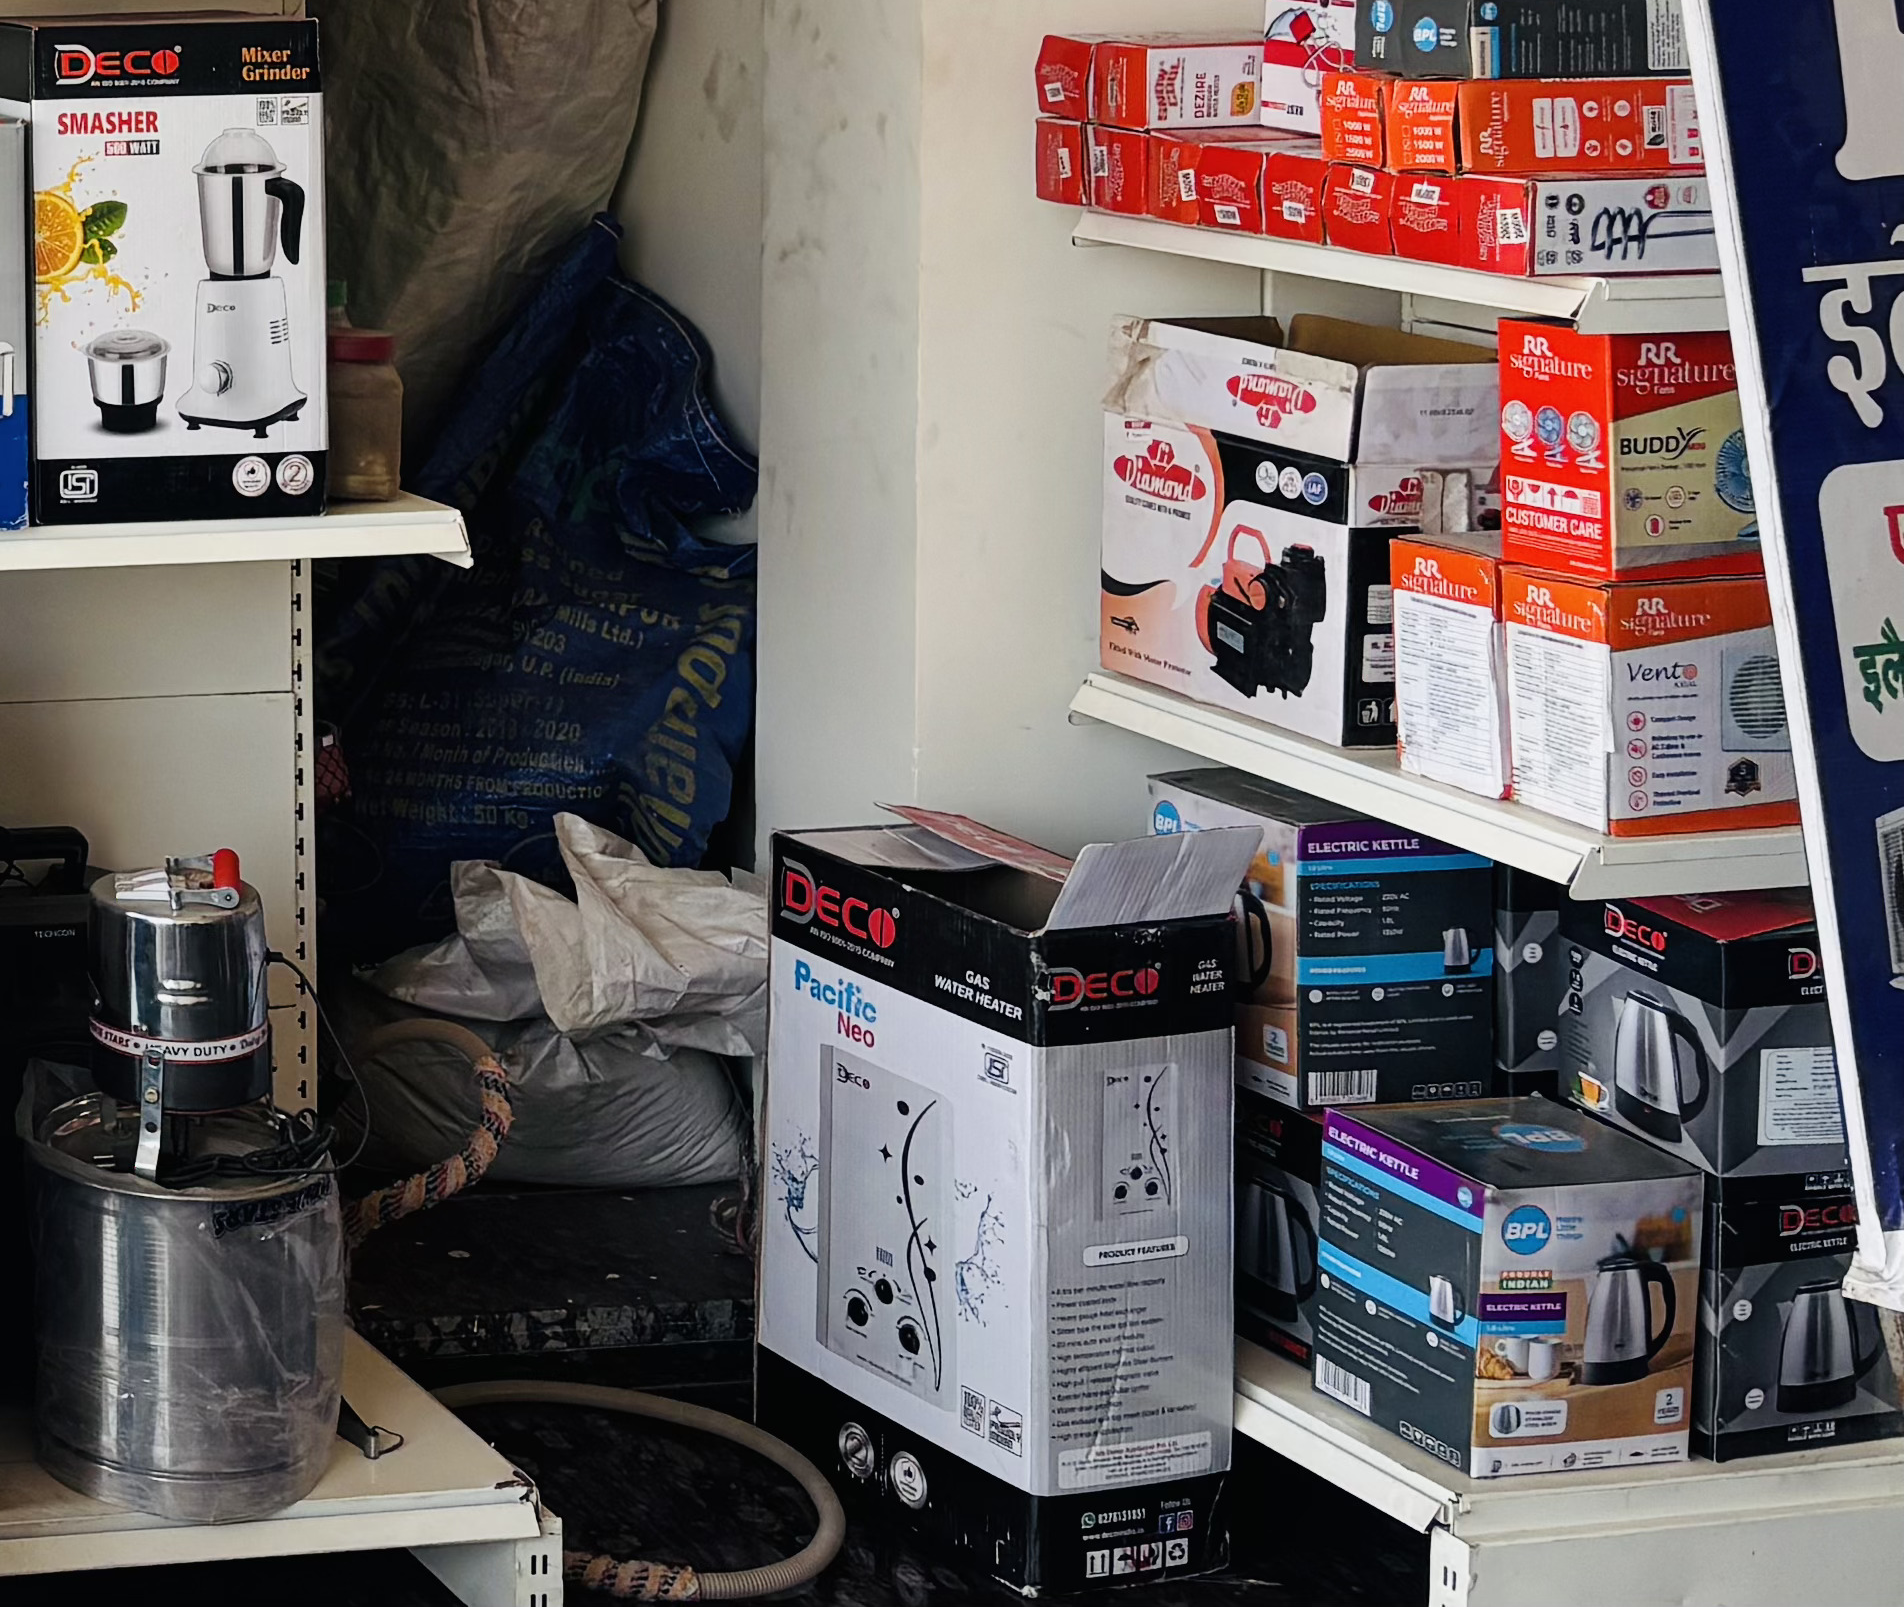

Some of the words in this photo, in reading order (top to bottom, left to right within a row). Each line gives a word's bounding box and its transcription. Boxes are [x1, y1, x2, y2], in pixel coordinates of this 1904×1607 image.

[55, 44, 180, 84] DECO
[242, 47, 291, 63] Mixer
[243, 64, 310, 81] Grinder
[1194, 72, 1207, 118] DEZIRE
[57, 112, 158, 136] SMASHER
[130, 141, 158, 154] WATT
[1308, 841, 1369, 854] ELECTRIC
[1372, 839, 1419, 851] KETTLE
[781, 856, 897, 948] DECO
[794, 959, 877, 1023] Pacific
[965, 970, 990, 989] GAS
[935, 975, 973, 1000] WATER
[975, 994, 1022, 1021] HEATER
[837, 1012, 875, 1048] Neo
